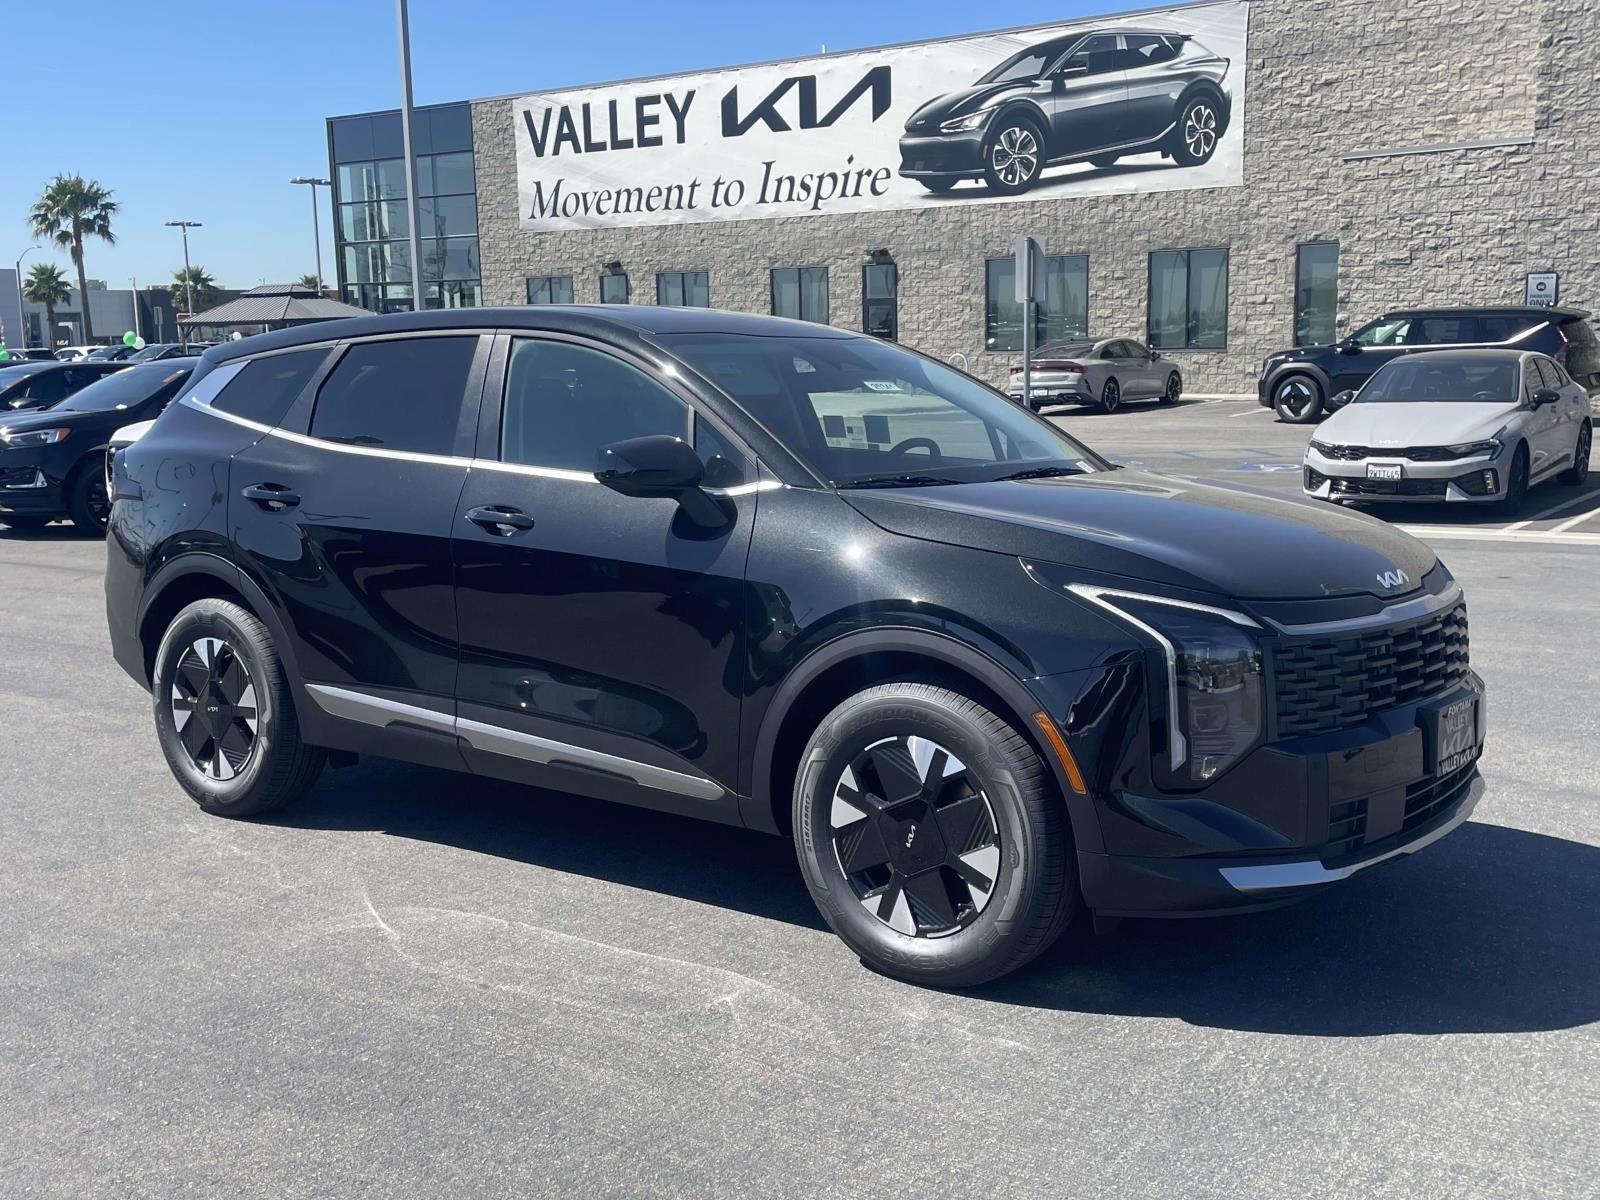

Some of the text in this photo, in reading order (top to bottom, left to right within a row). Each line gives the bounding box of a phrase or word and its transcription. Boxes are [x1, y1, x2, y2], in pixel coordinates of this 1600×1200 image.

[523, 65, 892, 158] VALLEY KIA
[528, 154, 891, 220] Movement to Inspire
[1376, 568, 1409, 589] KIA
[1446, 711, 1469, 734] VALLEY
[1441, 752, 1461, 776] VALLEY
[905, 824, 916, 849] KIA
